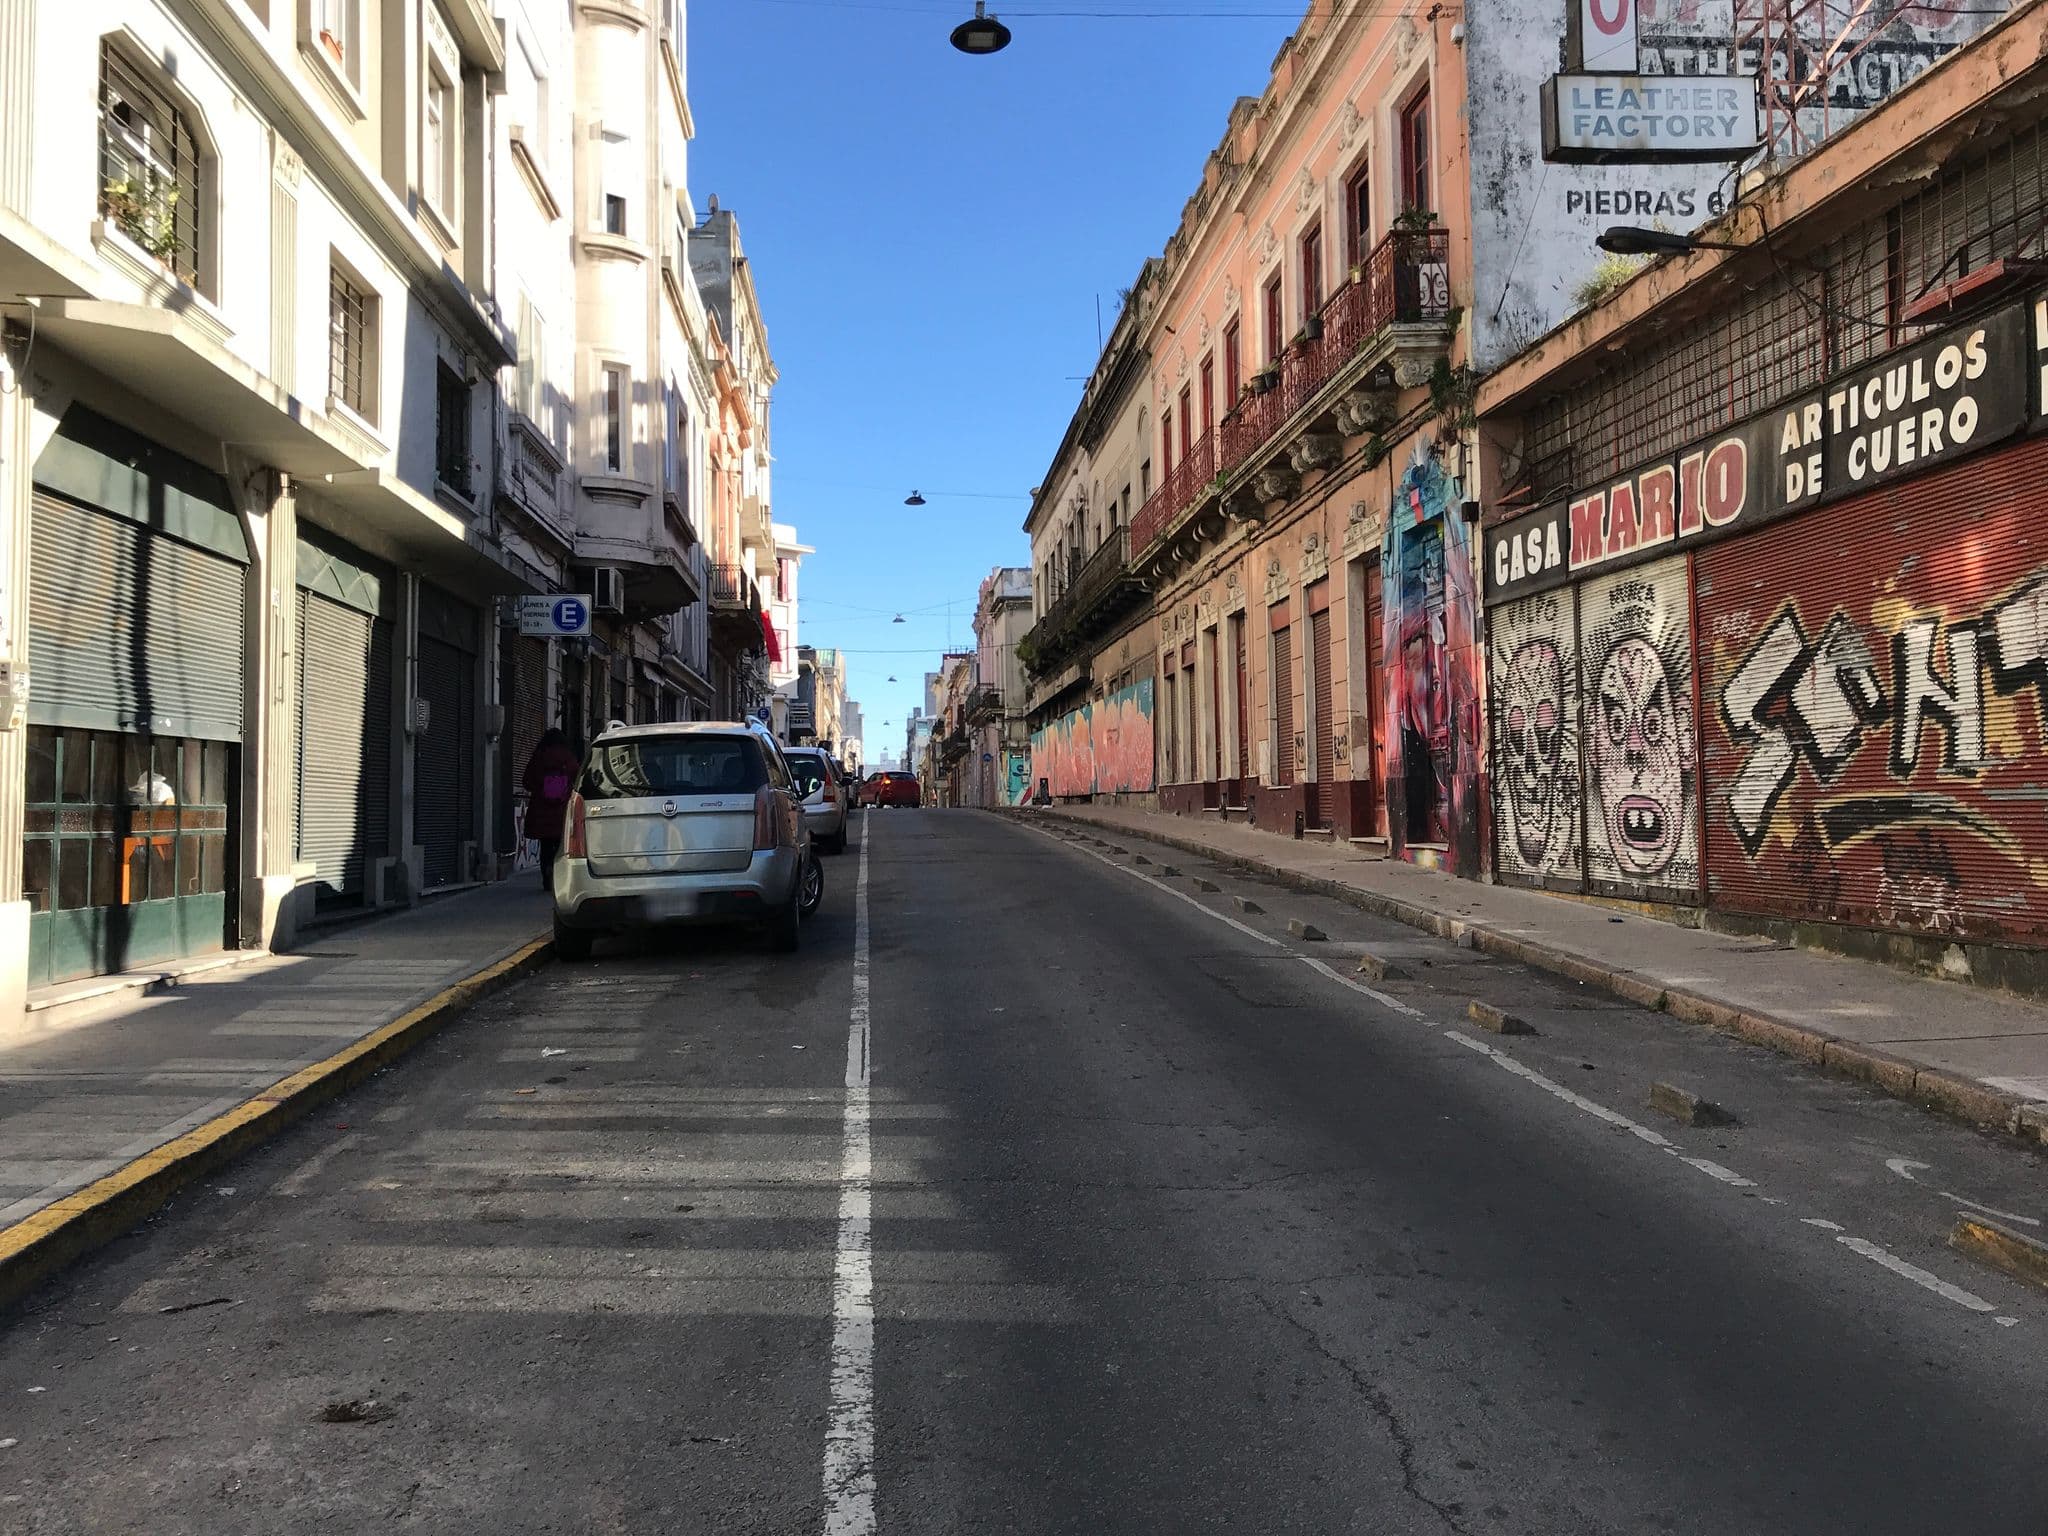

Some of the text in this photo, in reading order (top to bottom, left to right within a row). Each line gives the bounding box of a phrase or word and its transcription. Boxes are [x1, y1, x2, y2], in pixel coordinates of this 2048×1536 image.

[1572, 87, 1739, 111] LEATHER
[1573, 115, 1740, 138] FACTORY
[1566, 189, 1696, 216] PIEDRAS
[1780, 329, 1988, 455] ARTICULOS
[1785, 395, 1980, 504] DE CUERO
[1494, 437, 1748, 586] CASA MARIO
[561, 603, 577, 623] E
